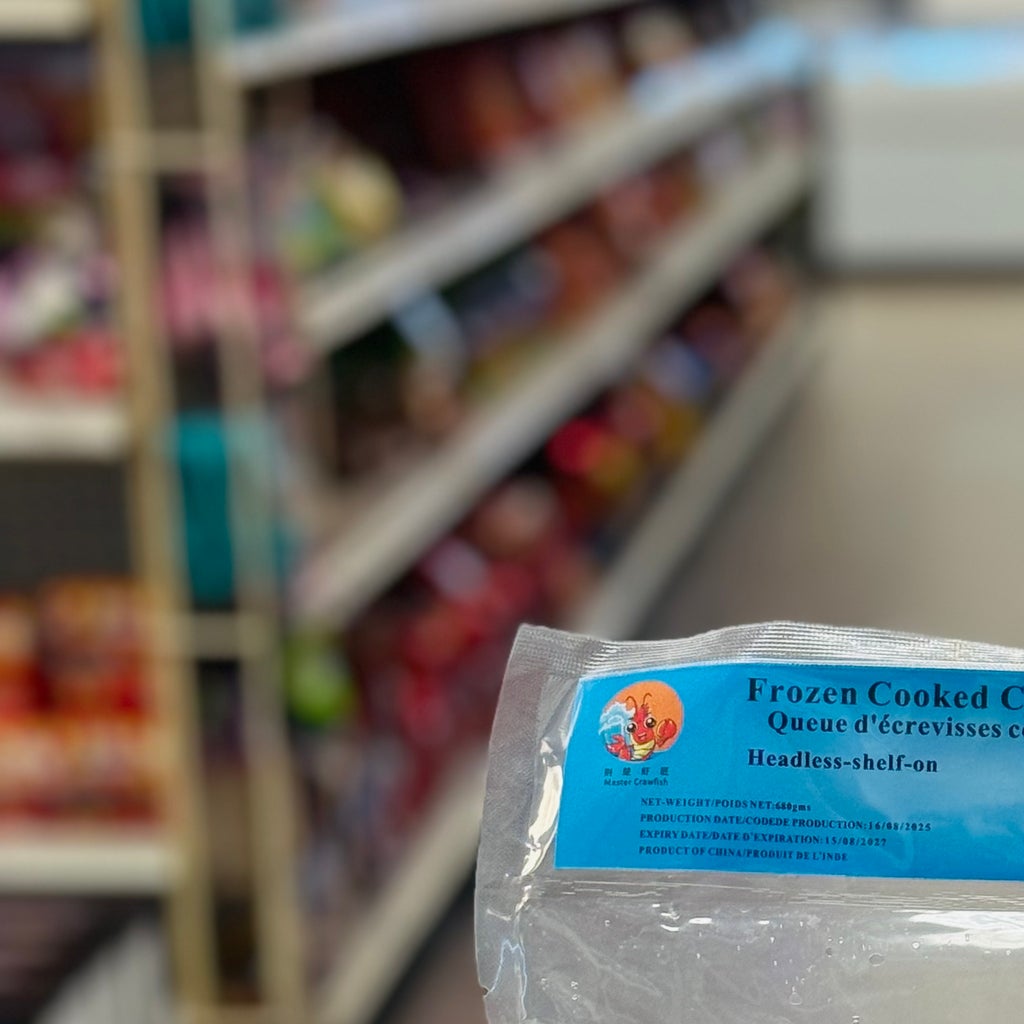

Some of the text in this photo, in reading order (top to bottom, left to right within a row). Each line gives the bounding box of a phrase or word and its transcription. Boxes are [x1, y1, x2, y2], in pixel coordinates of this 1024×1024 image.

[748, 678, 857, 705] Frozen
[868, 681, 988, 709] Cooked
[768, 711, 847, 735] Queue
[854, 714, 1001, 738] d'écrevisses
[748, 749, 938, 773] Headless-shelf-on
[641, 798, 748, 809] NET-WEIGHT/POIDS
[640, 813, 712, 824] PRODUCTION
[713, 815, 790, 827] DATE/CODEDE
[640, 829, 680, 839] EXPIRY
[681, 831, 741, 841] DATE/DATE
[639, 846, 690, 856] PRODUCT
[691, 847, 706, 856] OF
[796, 850, 809, 860] DE
